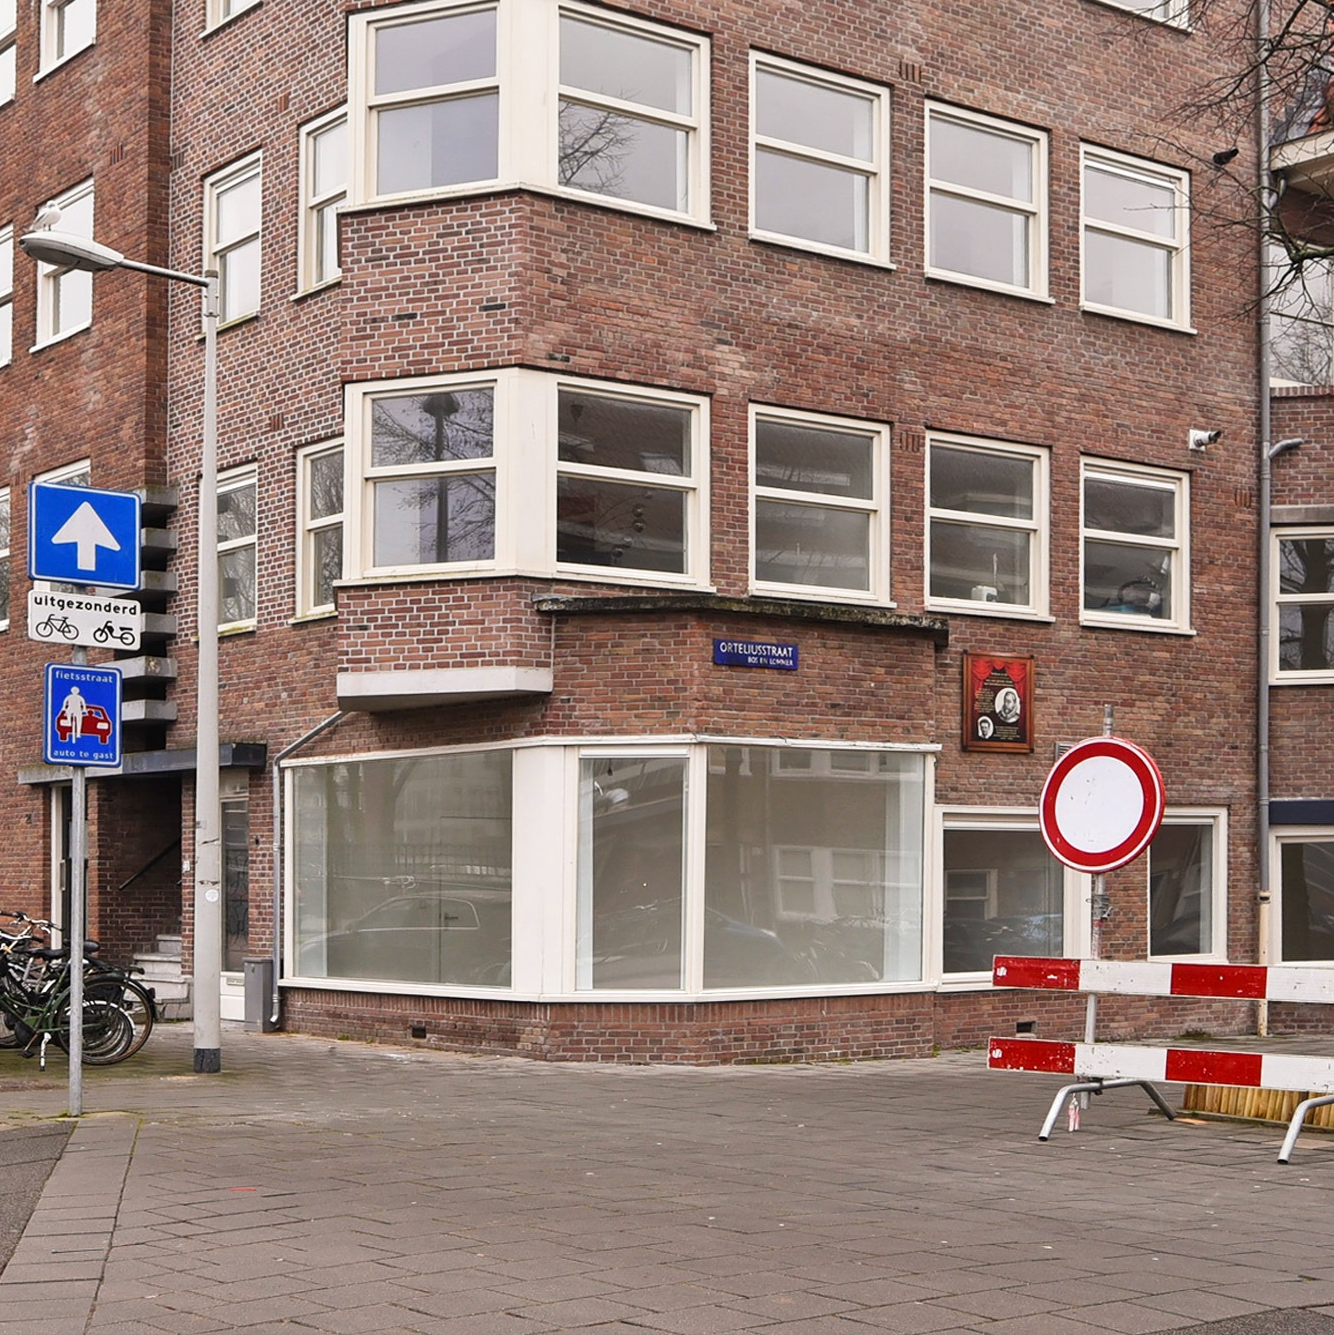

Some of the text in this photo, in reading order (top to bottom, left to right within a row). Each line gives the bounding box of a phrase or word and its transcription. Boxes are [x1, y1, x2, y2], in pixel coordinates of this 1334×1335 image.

[34, 595, 137, 615] uitgezonderd
[719, 642, 793, 657] ORTELIUSSTRAAT
[55, 670, 113, 683] fietsstraat
[53, 749, 114, 761] auto te gast
